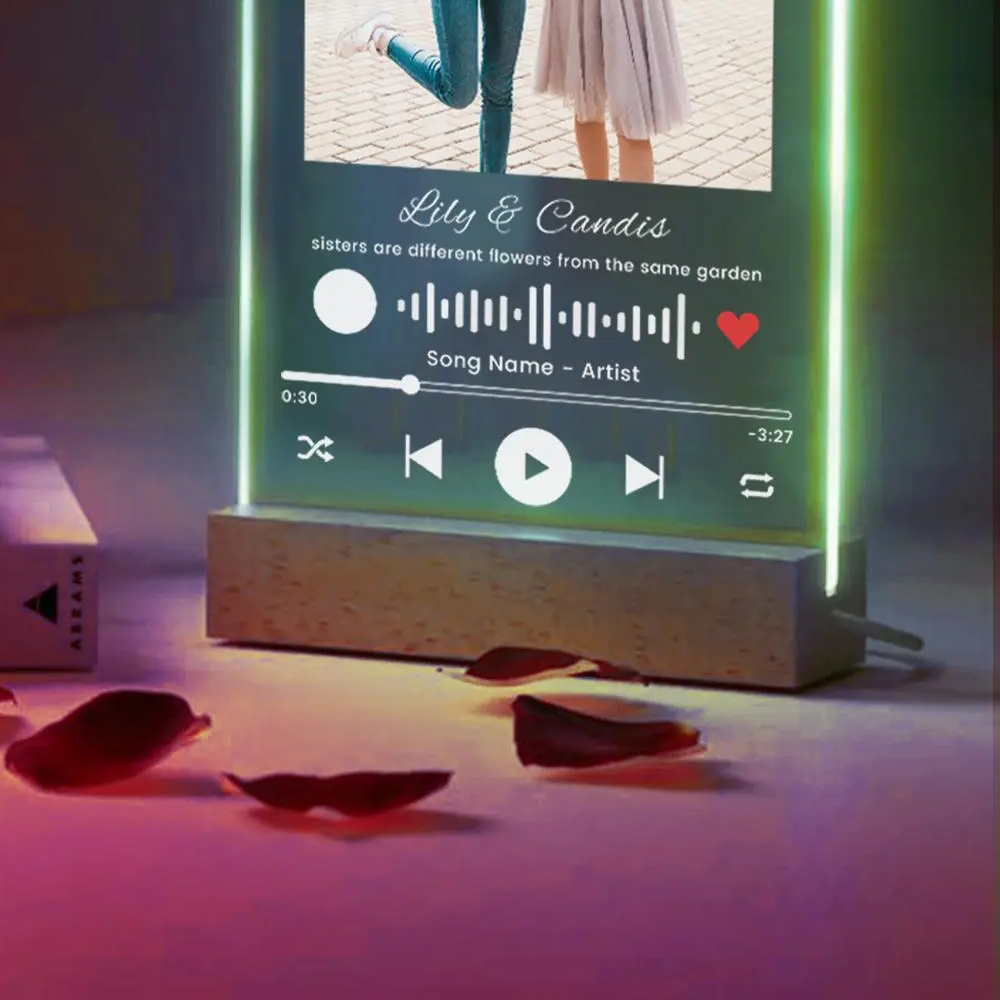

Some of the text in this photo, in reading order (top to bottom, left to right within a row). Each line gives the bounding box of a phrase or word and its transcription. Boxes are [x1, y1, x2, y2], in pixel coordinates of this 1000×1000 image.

[398, 187, 672, 239] Lily & Candis
[311, 235, 762, 283] sisters are different flowers from the same garden
[426, 349, 481, 376] Song
[489, 354, 554, 376] Name
[581, 362, 640, 383] Artist
[281, 389, 318, 405] 0:30
[748, 427, 794, 444] -3:27
[69, 555, 84, 651] ABRAMS
